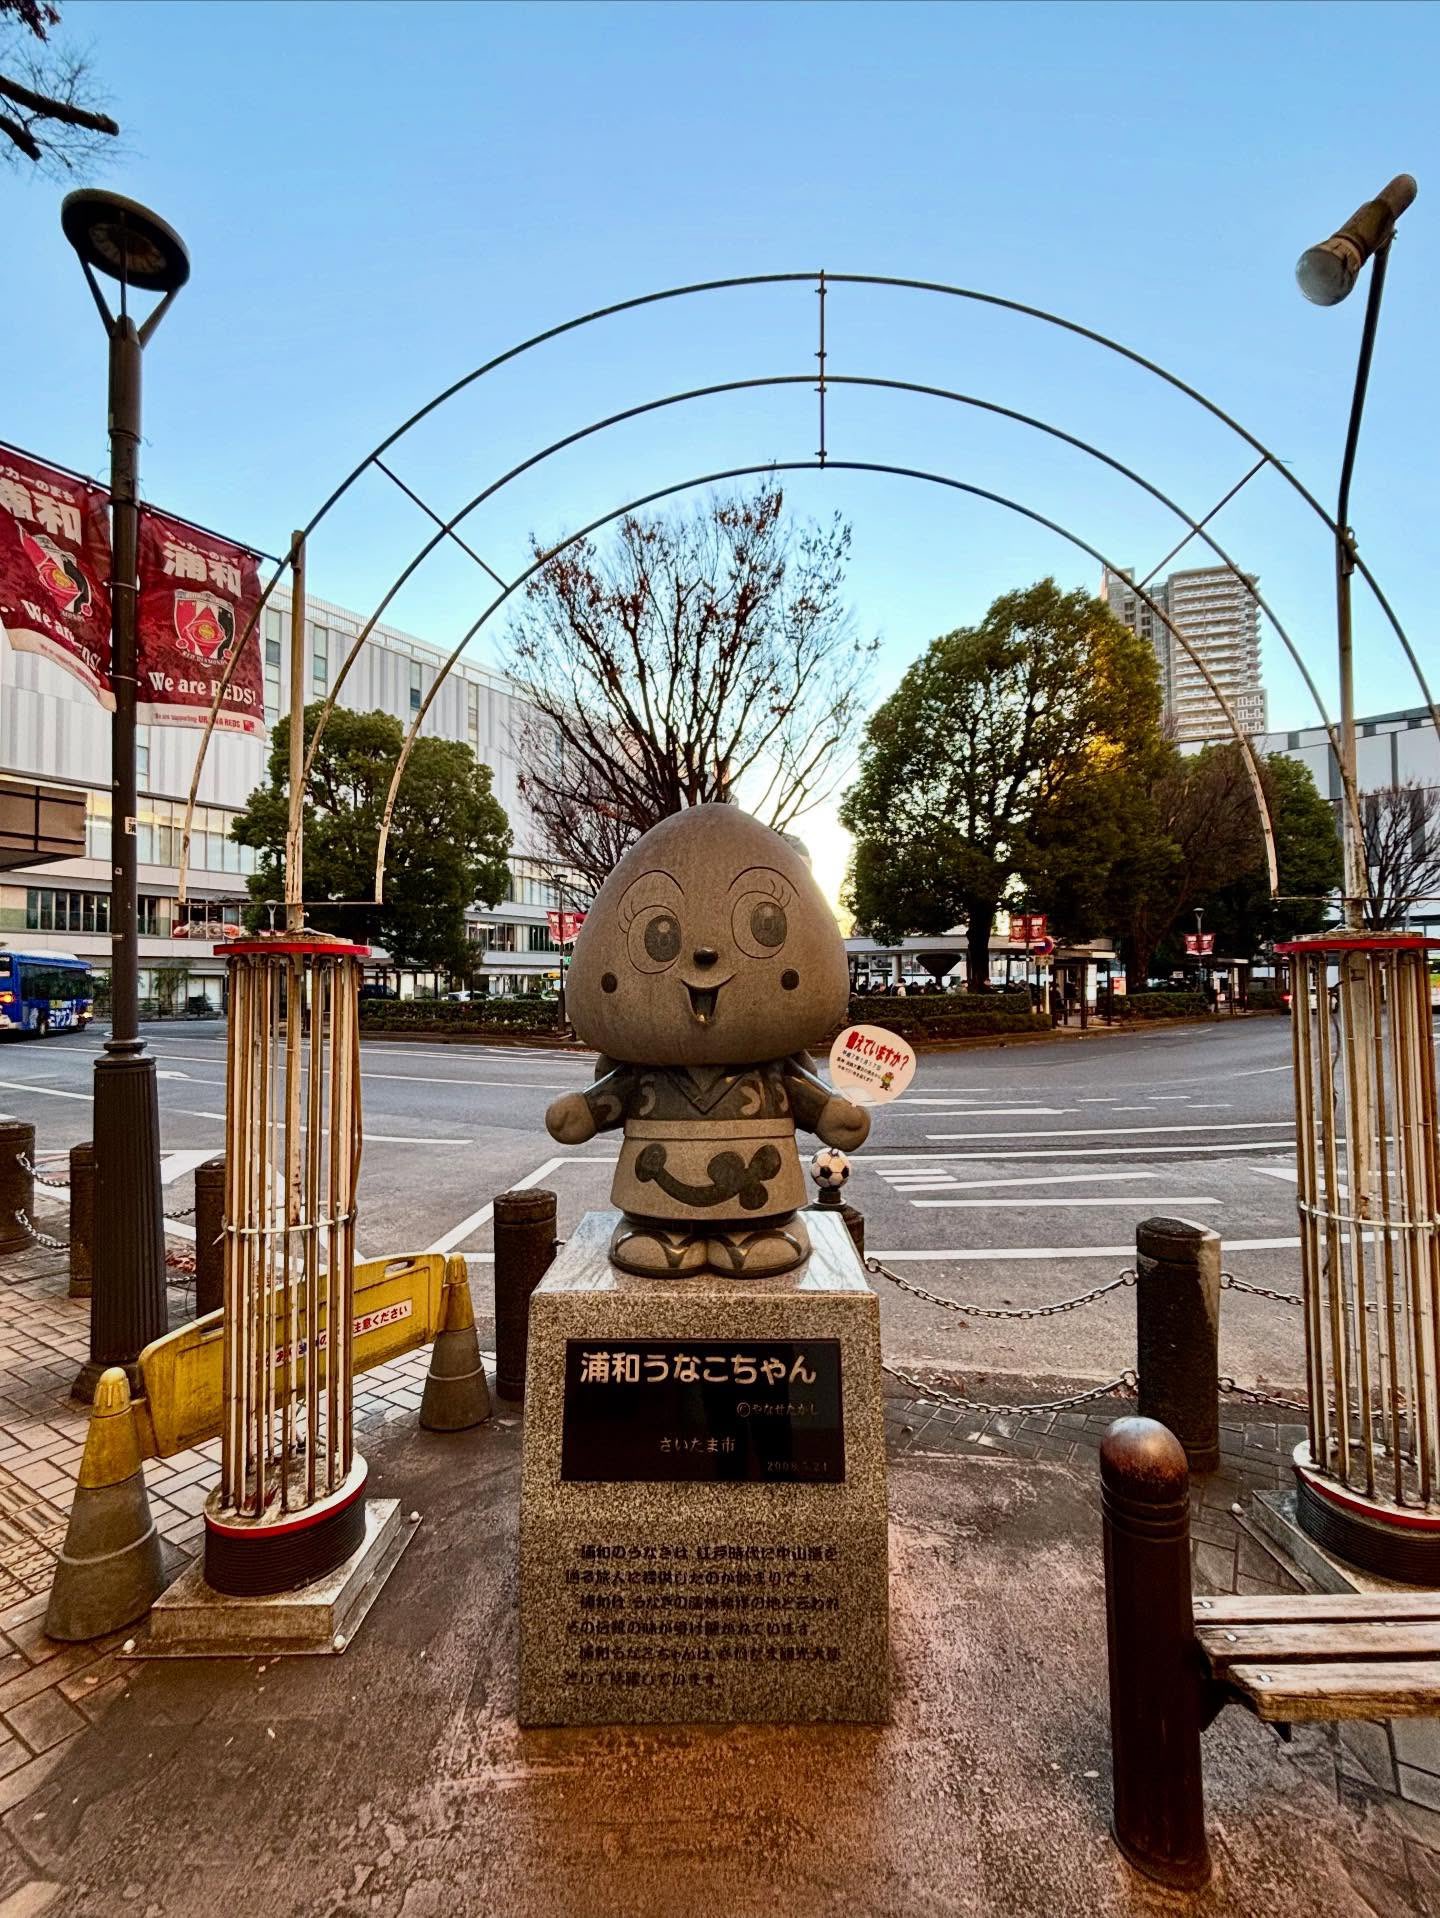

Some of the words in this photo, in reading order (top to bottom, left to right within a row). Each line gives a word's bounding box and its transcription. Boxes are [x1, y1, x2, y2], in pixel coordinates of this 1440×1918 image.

[161, 540, 243, 599] 浦和
[20, 598, 53, 629] We
[147, 671, 174, 692] We
[178, 677, 206, 695] are
[580, 1351, 817, 1386] 浦和うなこちゃん
[660, 1437, 736, 1454] さいたま市
